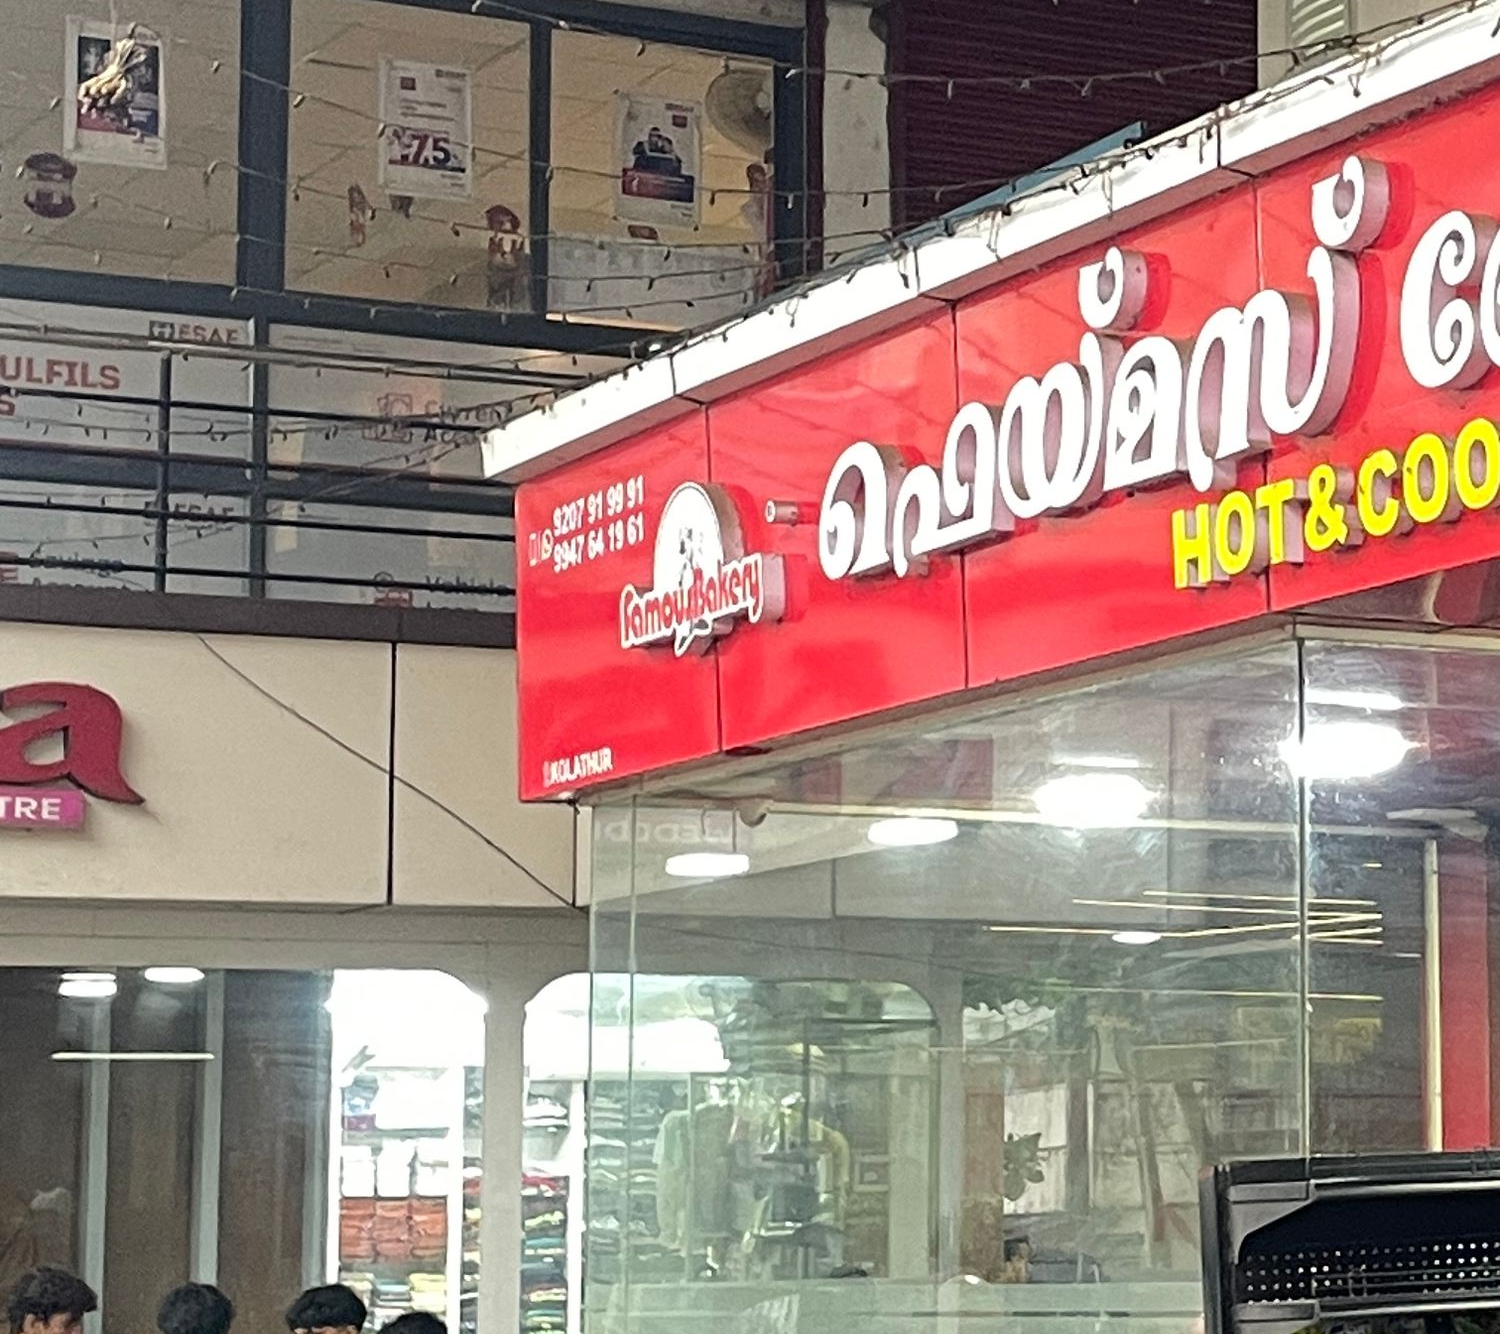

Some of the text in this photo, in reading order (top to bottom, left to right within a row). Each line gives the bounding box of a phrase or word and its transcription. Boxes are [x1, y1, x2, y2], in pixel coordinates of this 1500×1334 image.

[553, 474, 644, 537] 9207 91 99 91
[553, 534, 585, 574] 9947
[607, 519, 624, 552] 19
[626, 511, 644, 546] 61
